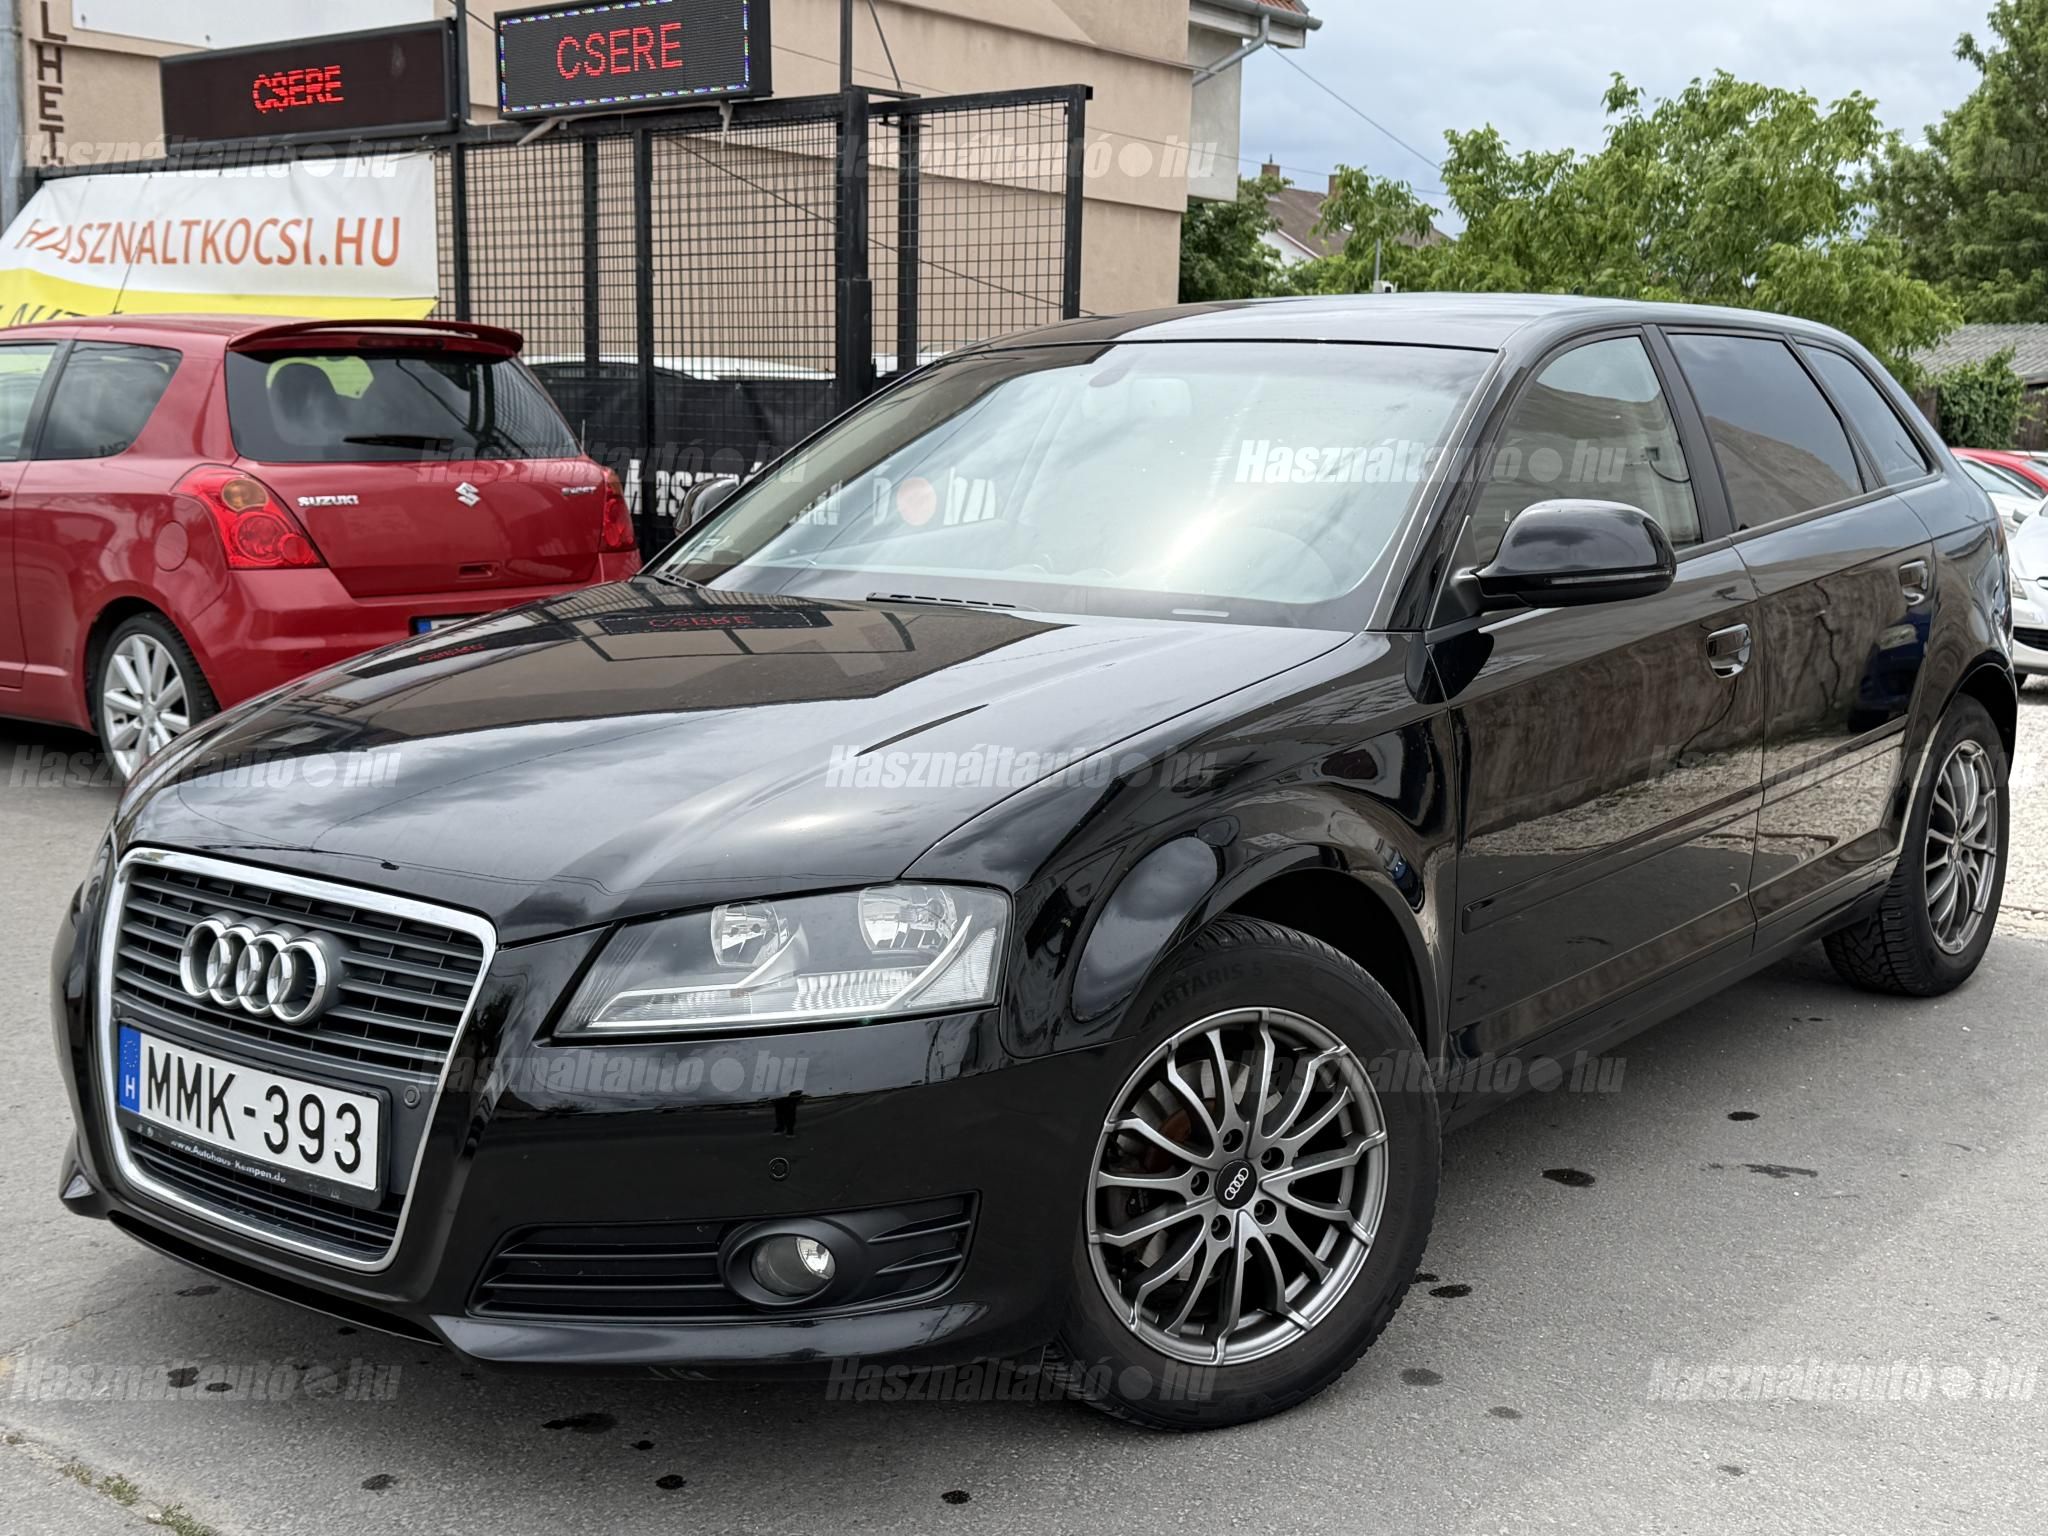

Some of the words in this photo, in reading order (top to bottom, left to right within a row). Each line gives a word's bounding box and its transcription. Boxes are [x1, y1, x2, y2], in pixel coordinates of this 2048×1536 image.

[556, 22, 683, 80] CSERE
[252, 64, 344, 114] CSERE
[14, 216, 402, 267] HASZNALTKOCSI.HU
[297, 494, 360, 507] SUZUKI
[125, 1074, 136, 1100] H
[148, 1046, 362, 1174] MMK-393
